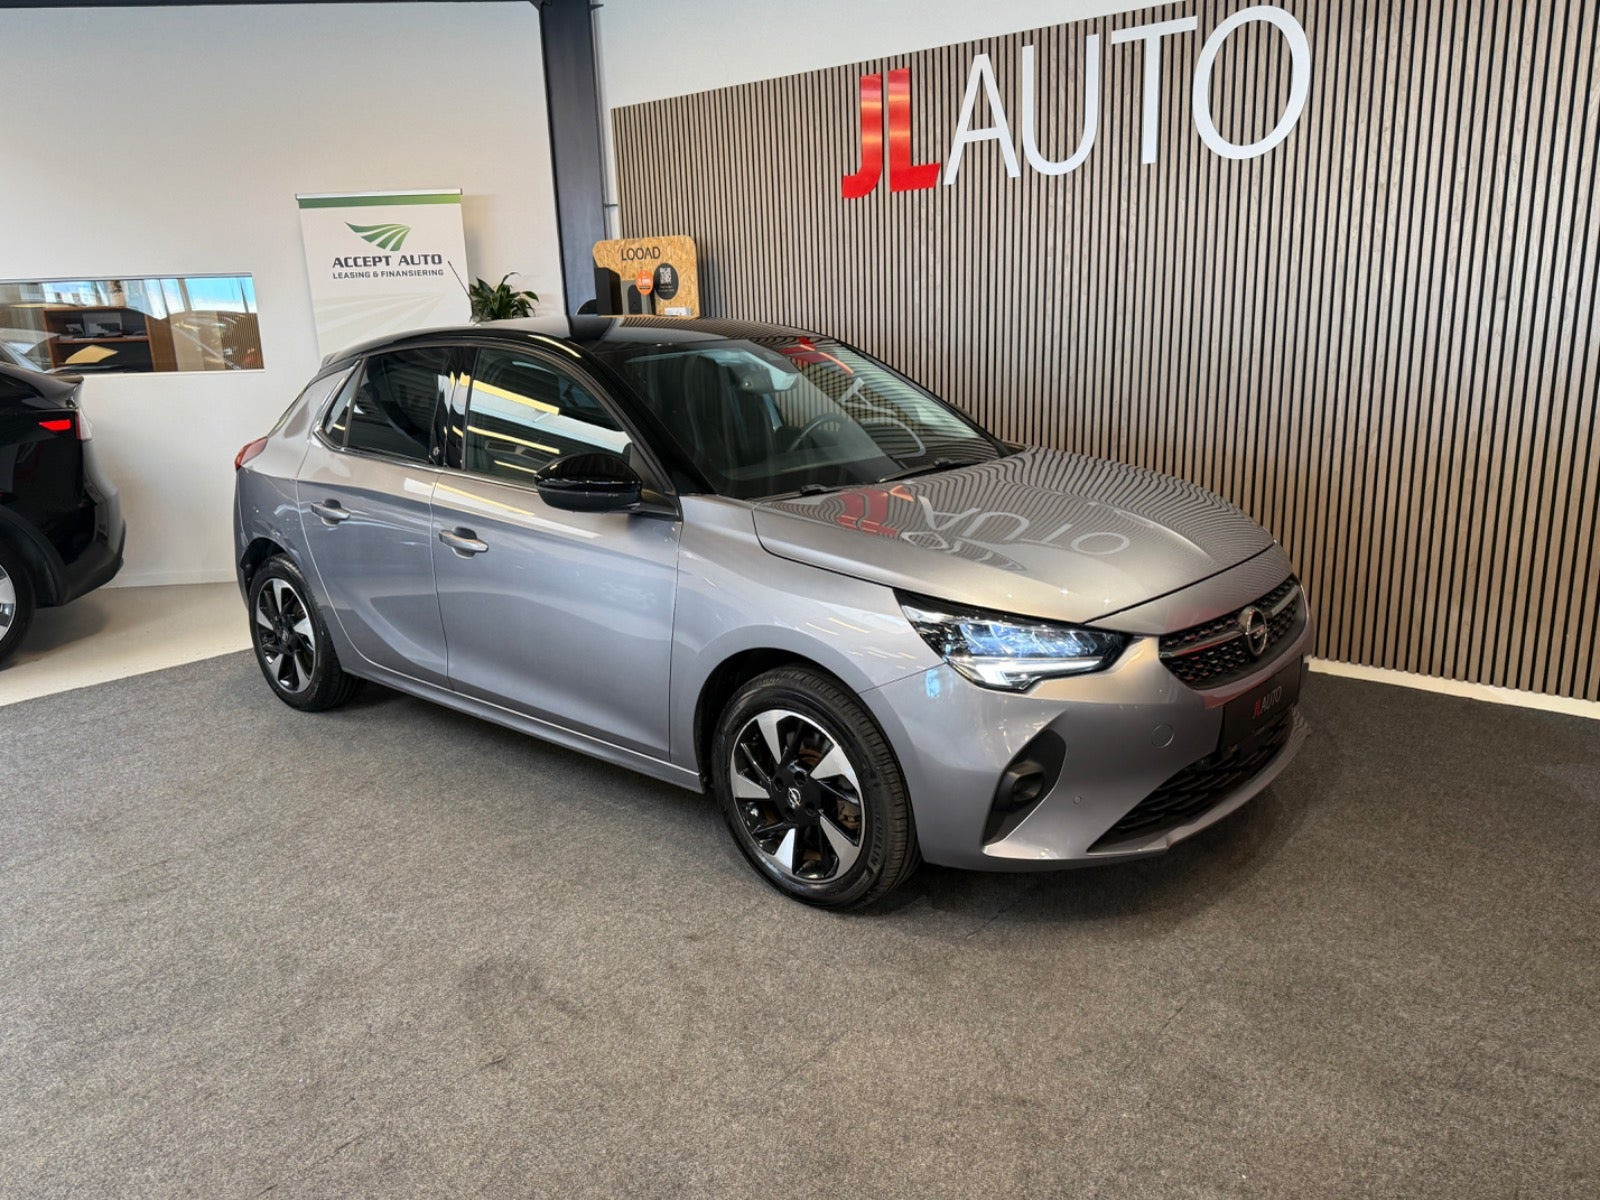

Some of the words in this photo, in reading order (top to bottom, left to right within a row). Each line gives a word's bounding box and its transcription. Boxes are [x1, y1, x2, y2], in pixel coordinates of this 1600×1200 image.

[332, 255, 392, 268] ACCEPT
[398, 253, 443, 266] AUTO
[621, 246, 661, 261] LOOAD
[332, 271, 371, 280] LEASING
[380, 269, 444, 278] FINANSIERING
